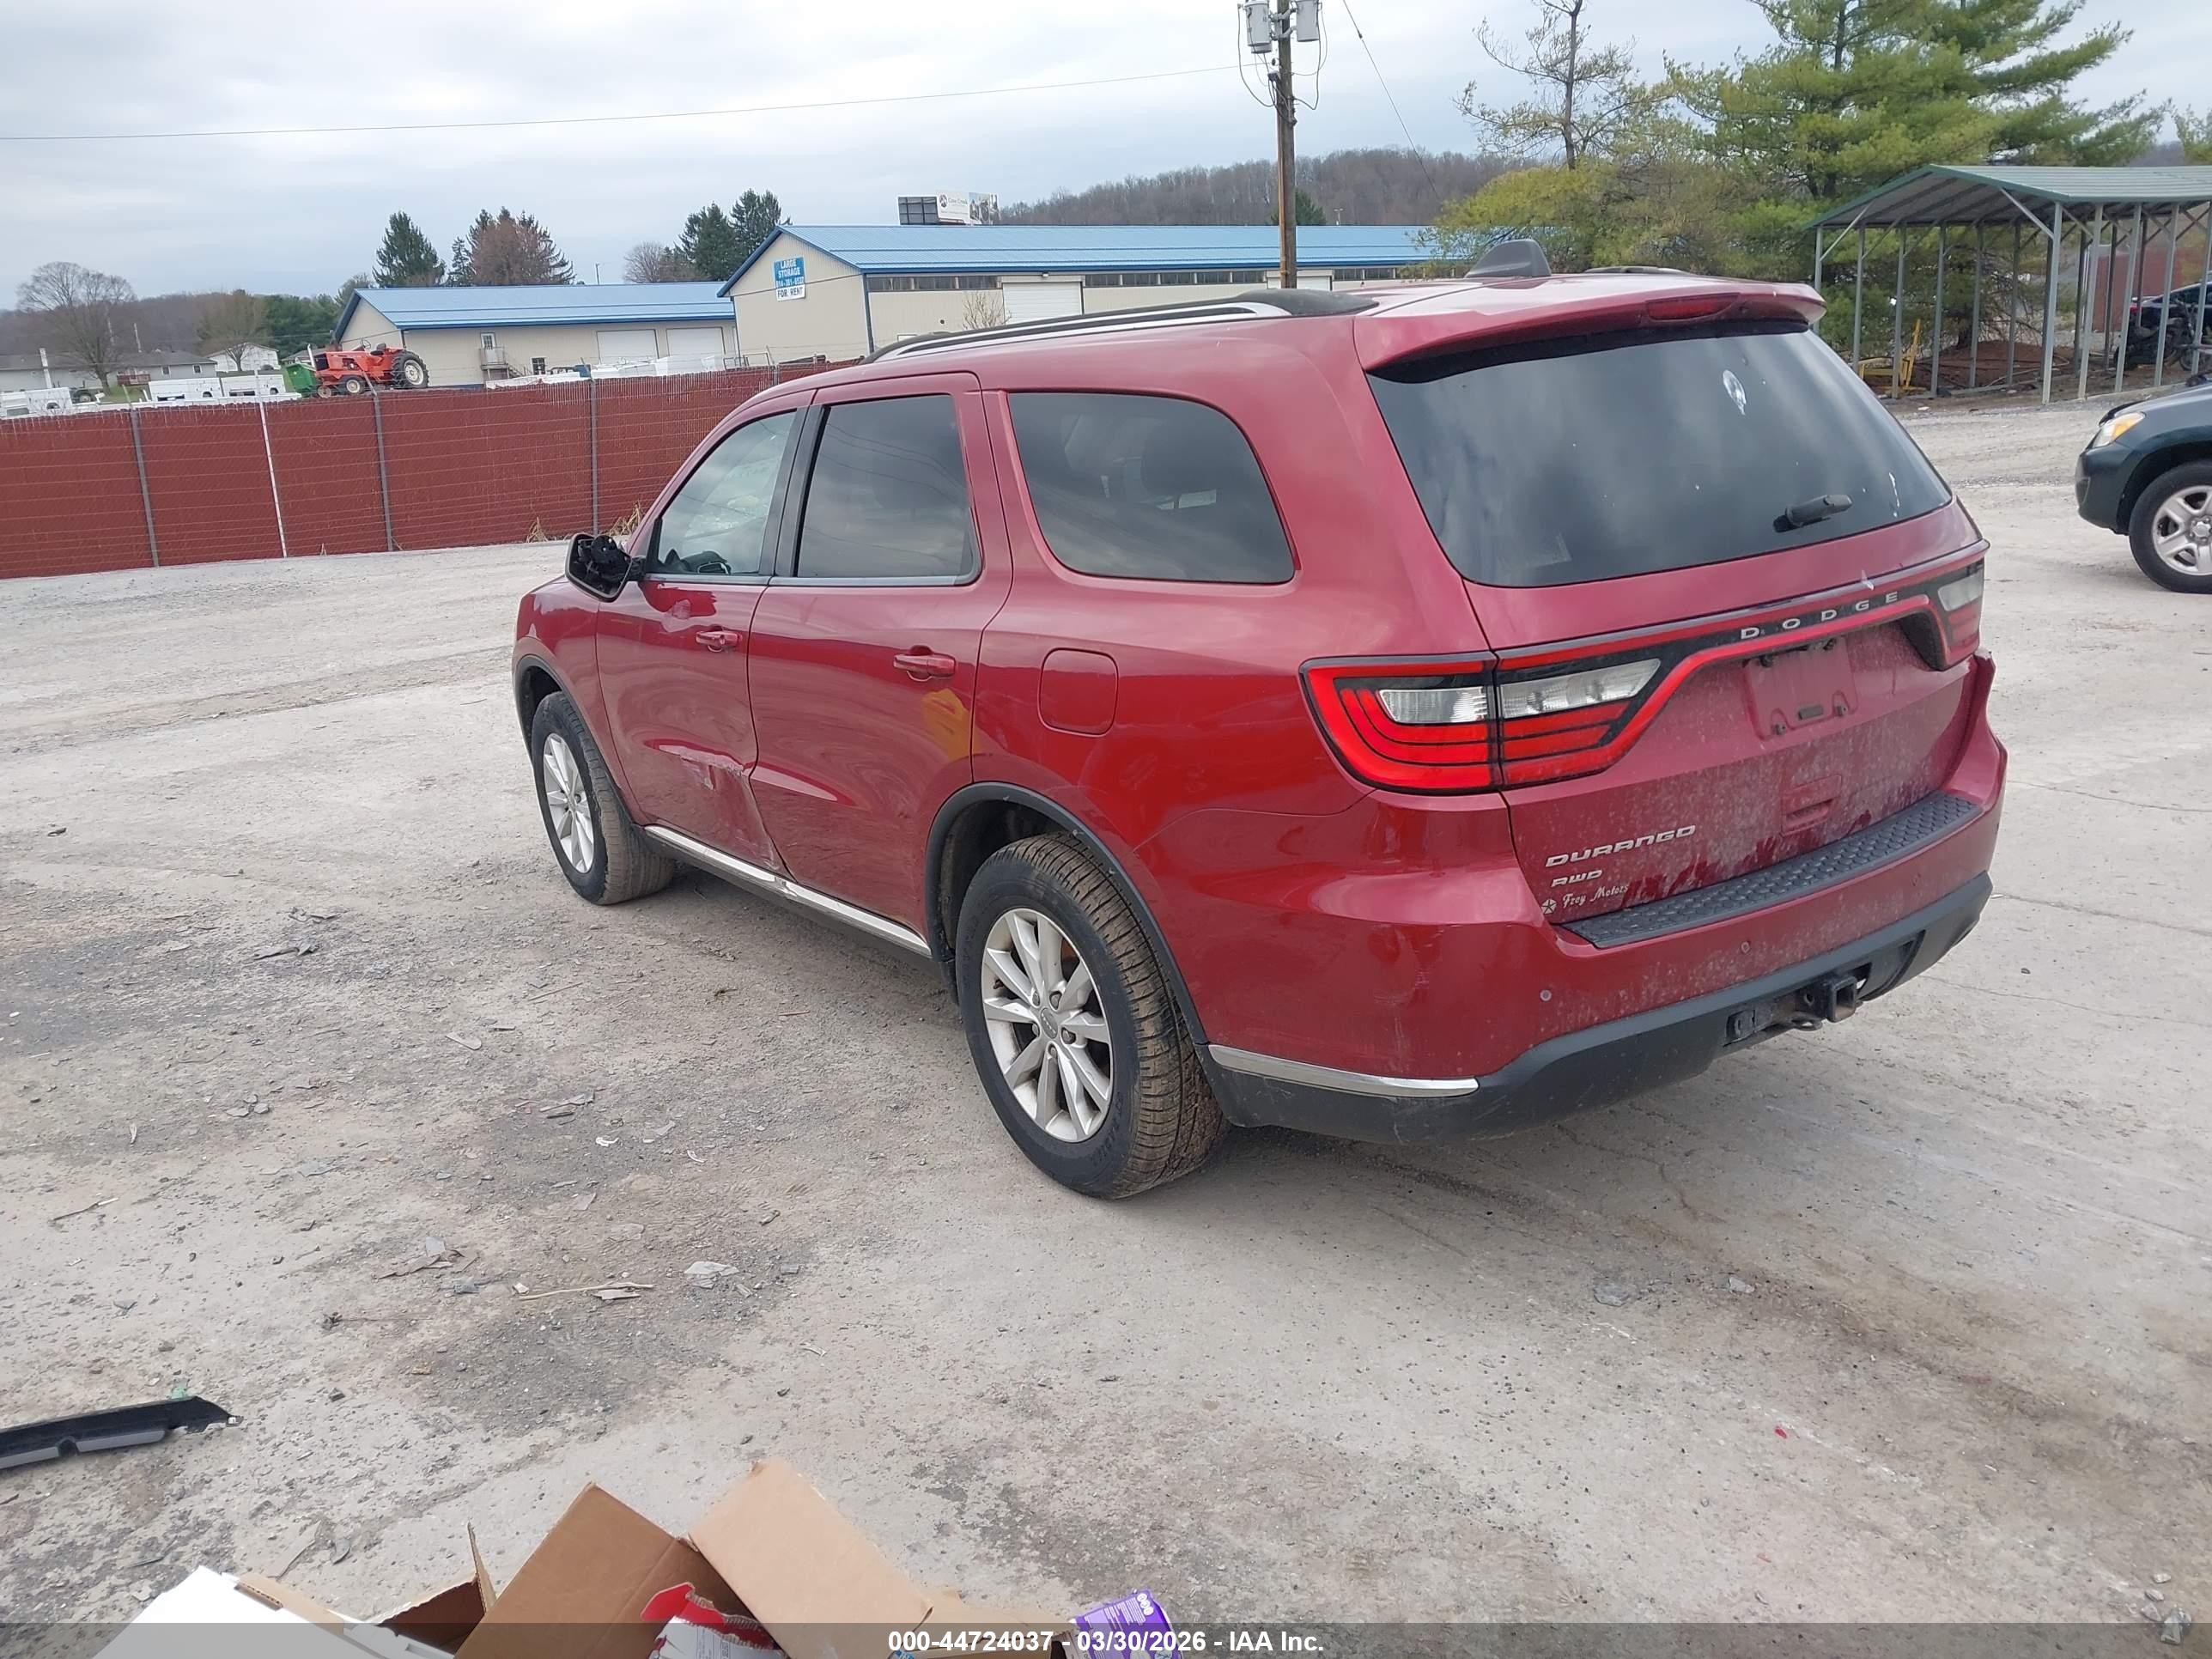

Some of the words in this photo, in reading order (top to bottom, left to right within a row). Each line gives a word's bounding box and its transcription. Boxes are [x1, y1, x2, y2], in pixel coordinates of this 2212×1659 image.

[778, 267, 800, 278] STORAGE
[780, 259, 797, 269] LARGE
[777, 289, 787, 298] FOR
[790, 287, 803, 296] RENT
[1741, 592, 1899, 640] DODGE
[1545, 824, 1696, 867] DURANGO
[1551, 869, 1603, 888] AWD
[1589, 884, 1629, 902] Motors
